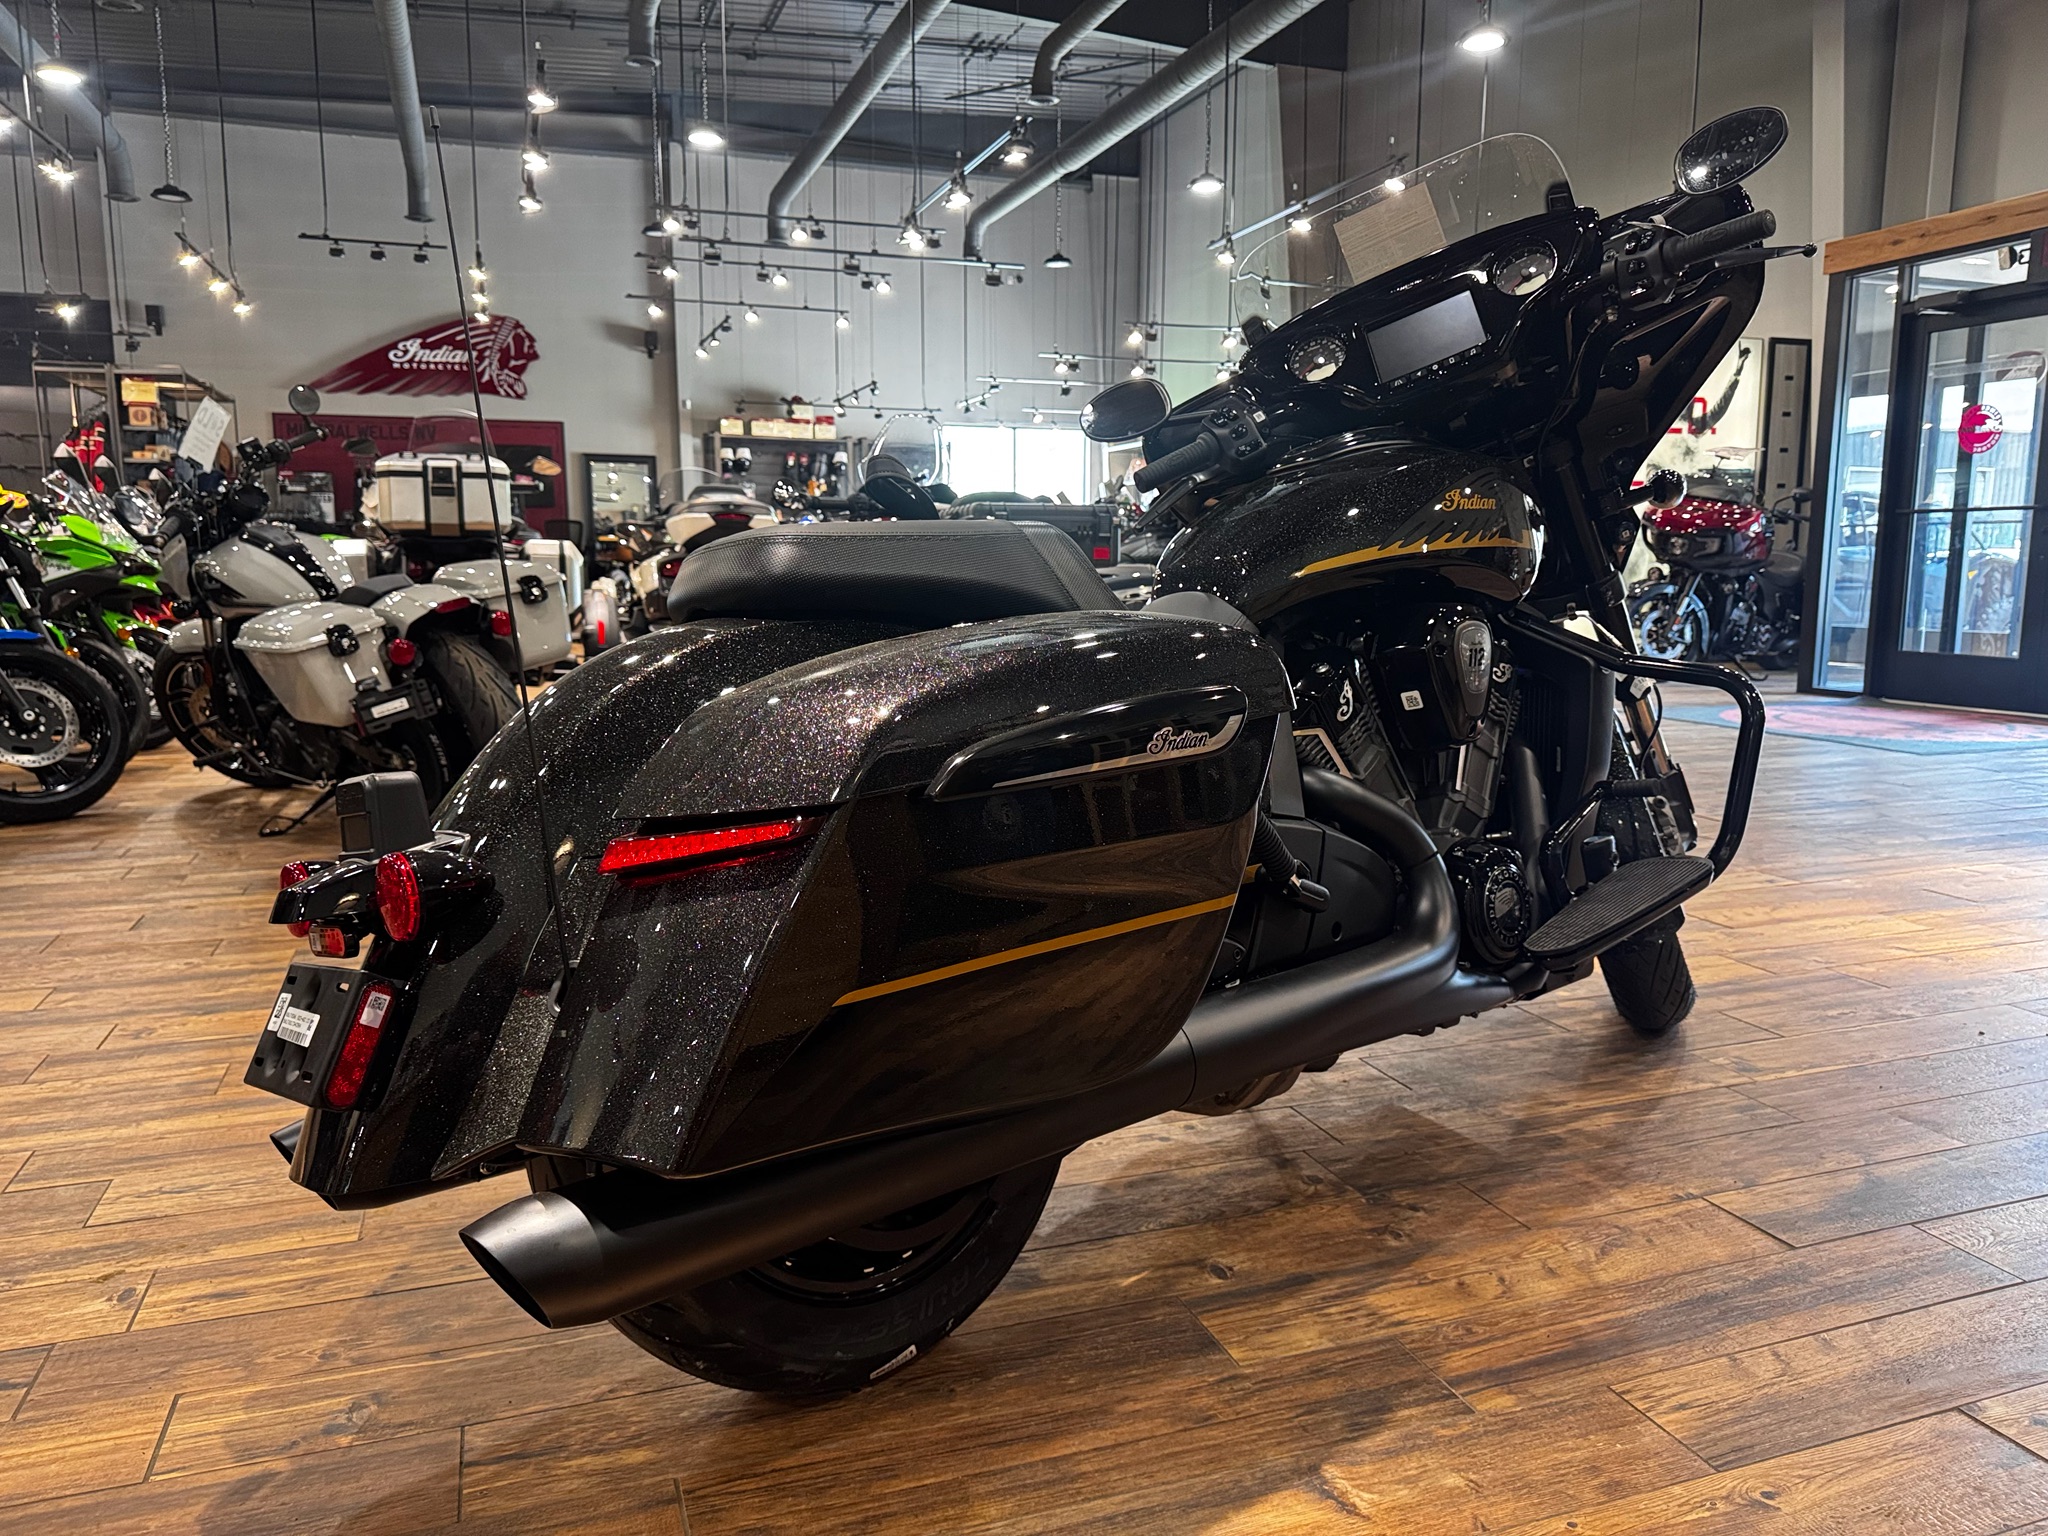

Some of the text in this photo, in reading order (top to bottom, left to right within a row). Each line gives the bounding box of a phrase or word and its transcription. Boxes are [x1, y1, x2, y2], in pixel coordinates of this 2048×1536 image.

[388, 338, 479, 363] Indian
[392, 362, 471, 371] MOTORCYCL
[357, 424, 409, 440] WELLS
[1441, 489, 1497, 512] Indian
[1468, 646, 1485, 667] 112
[1147, 727, 1209, 755] Indian
